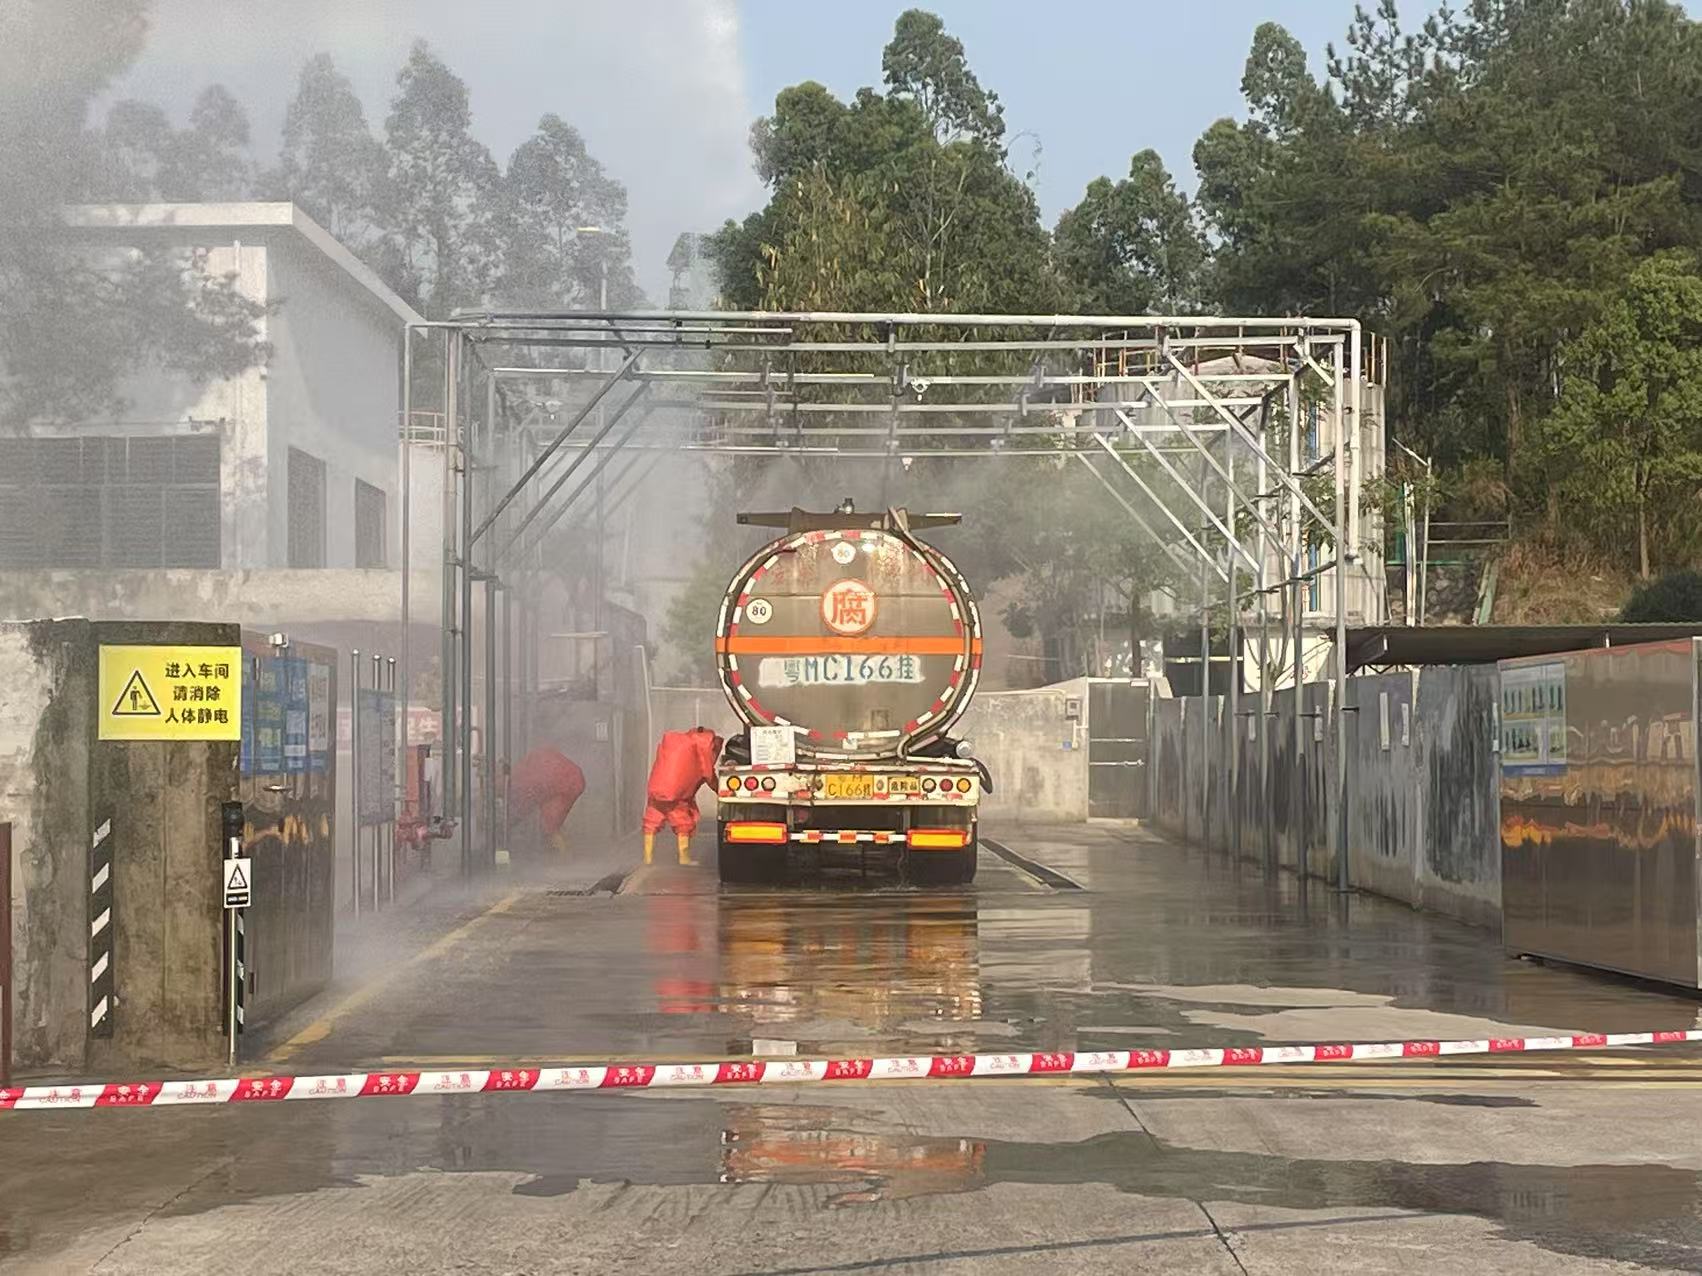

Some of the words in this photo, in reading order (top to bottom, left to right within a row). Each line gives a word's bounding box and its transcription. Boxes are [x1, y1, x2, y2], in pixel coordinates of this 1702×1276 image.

[752, 605, 767, 617] 80
[831, 589, 868, 625] 腐
[165, 662, 229, 679] 进入车间
[784, 656, 914, 683] 粤MC166挂
[173, 685, 221, 701] 请消除
[165, 707, 229, 724] 人体静电
